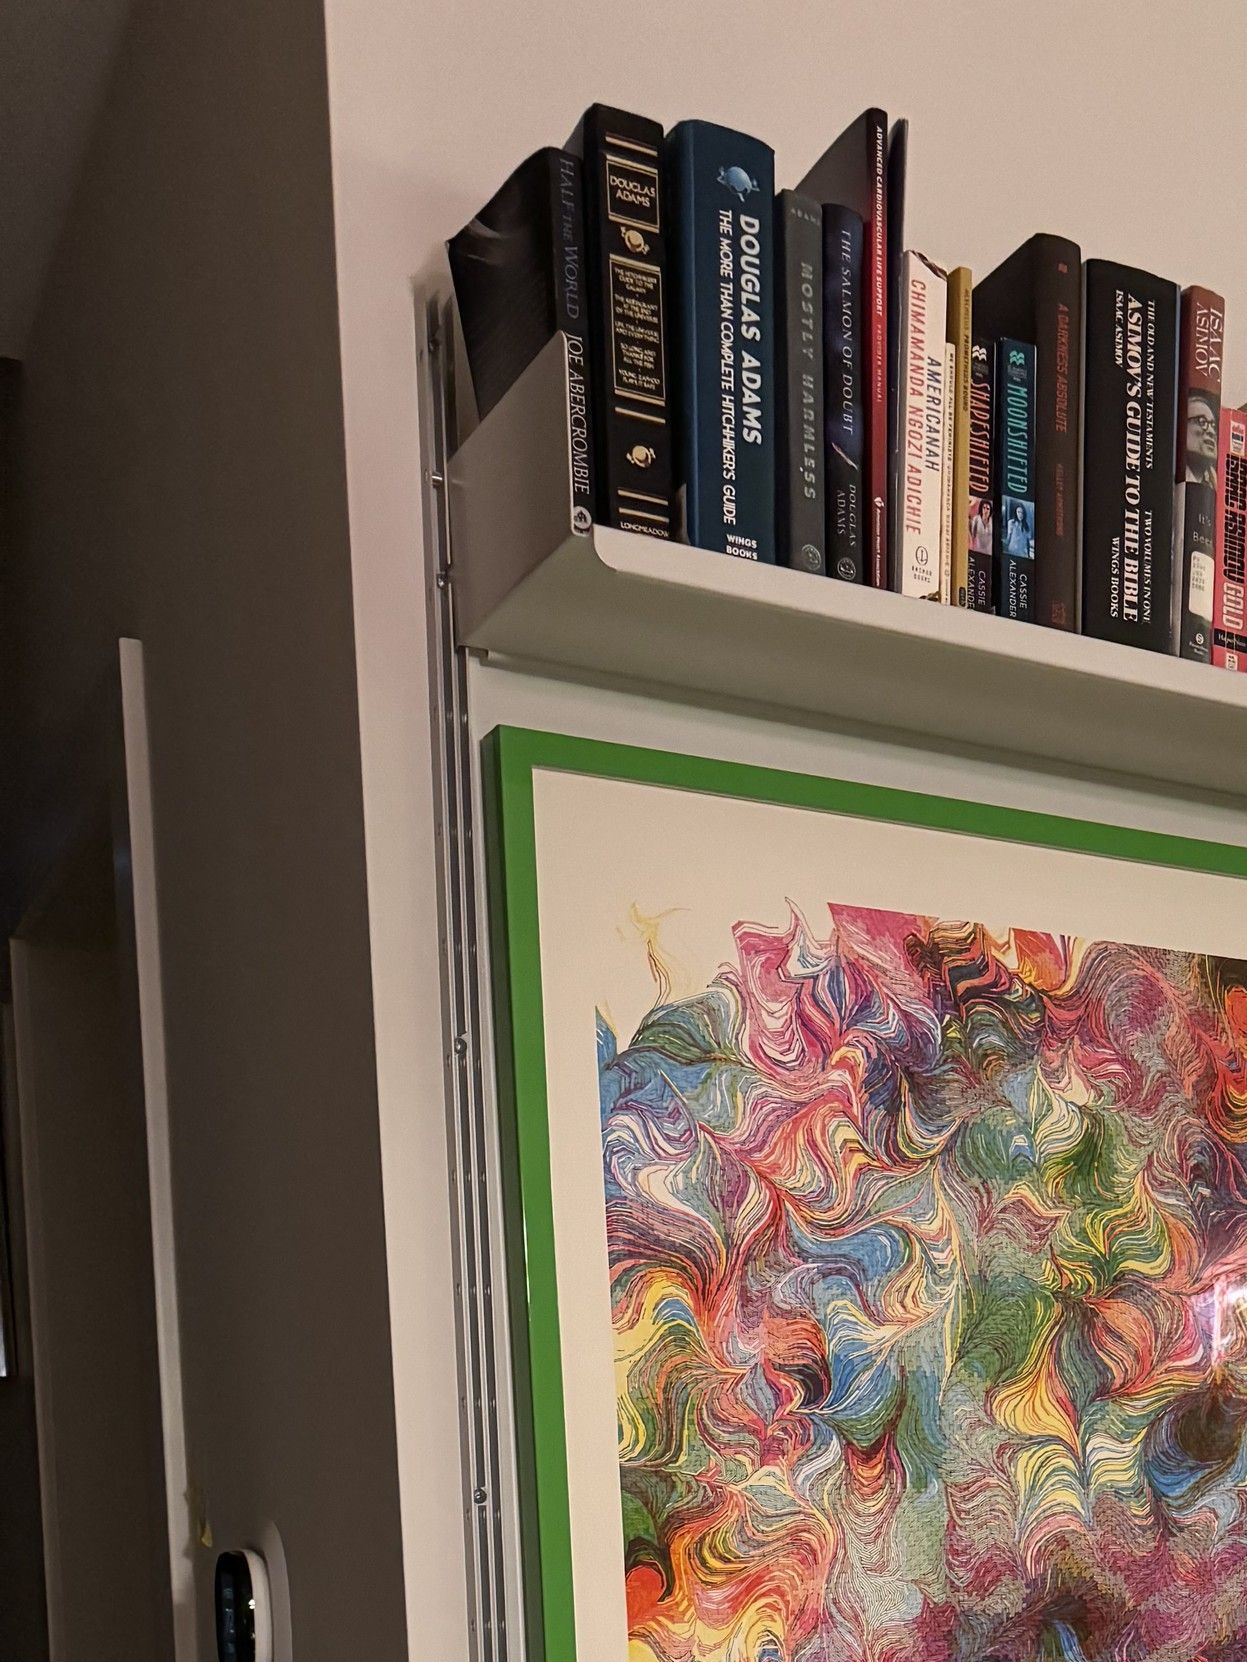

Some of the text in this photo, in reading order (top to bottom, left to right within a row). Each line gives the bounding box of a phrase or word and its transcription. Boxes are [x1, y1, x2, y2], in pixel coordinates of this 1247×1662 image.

[609, 175, 656, 198] DOUGLAS
[876, 125, 884, 174] ADVANCED
[615, 190, 650, 208] ADAMS
[876, 175, 884, 253] CARDIOVASCULAR
[718, 209, 737, 526] THE MORE THAN COMPLETE HITCHHIKER'S GUIDE
[739, 214, 763, 446] DOUGLAS ADAMS
[840, 229, 854, 435] THE SALMON OF DOUBT
[1194, 302, 1210, 377] ASIMOV
[1207, 307, 1223, 380] ISAAC
[565, 332, 590, 495] JOE ABERCROMBIE
[800, 262, 816, 500] MOSTLY HARMLESS
[905, 279, 927, 536] CHIMAMANDA NGOZI ADICHIE
[924, 355, 943, 473] AMERICANAH
[968, 381, 991, 494] SHAPESHIFTED
[1006, 383, 1029, 494] MOONSHIFTED
[1122, 294, 1143, 624] ASIMOV'S GUIDE TO THE BIBLE
[725, 545, 758, 561] BOOKS
[726, 533, 758, 549] WINGS
[1109, 536, 1120, 619] WINGS BOOKS
[1009, 559, 1018, 618] ALEXANDER
[1019, 573, 1028, 609] CASSIE
